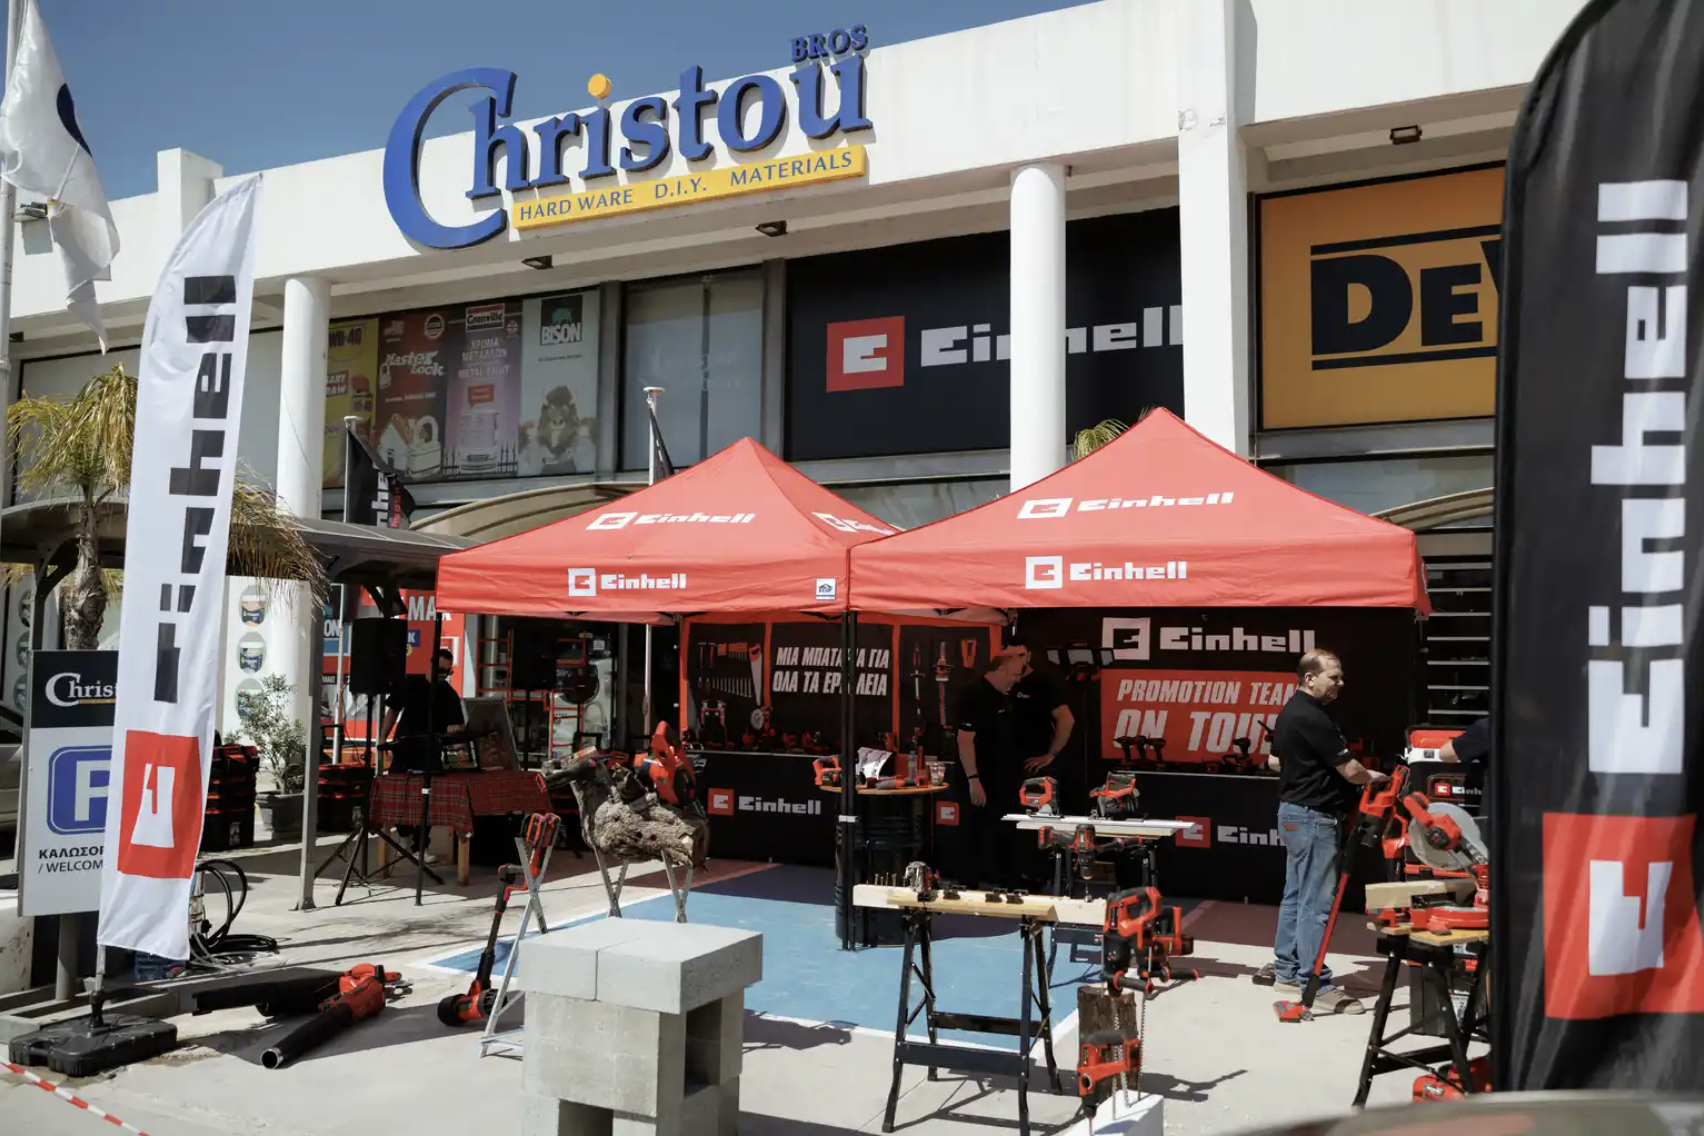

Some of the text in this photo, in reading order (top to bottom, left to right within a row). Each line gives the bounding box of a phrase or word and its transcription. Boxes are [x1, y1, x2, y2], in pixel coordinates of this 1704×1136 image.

[789, 23, 868, 62] BROS
[383, 54, 874, 249] Christou
[655, 177, 707, 199] D.I.Y.
[730, 151, 852, 186] MATERIALS
[466, 309, 504, 325] Granville
[542, 321, 581, 344] BISON
[385, 350, 439, 367] Master
[410, 361, 446, 377] Lock
[1588, 179, 1689, 774] Einhell
[1077, 492, 1235, 511] Einhell
[634, 512, 756, 525] Einhell
[601, 573, 687, 590] Einhell
[1070, 561, 1187, 581] Einhell
[1159, 627, 1315, 653] Einhell
[801, 647, 866, 668] ΜΠΑΤΑΑ
[45, 672, 116, 707] Chris
[822, 671, 888, 696] ΕΡΛΕΙΑ
[1117, 679, 1241, 705] PROMOTION
[1113, 709, 1168, 750] ON
[738, 795, 821, 816] Einhell
